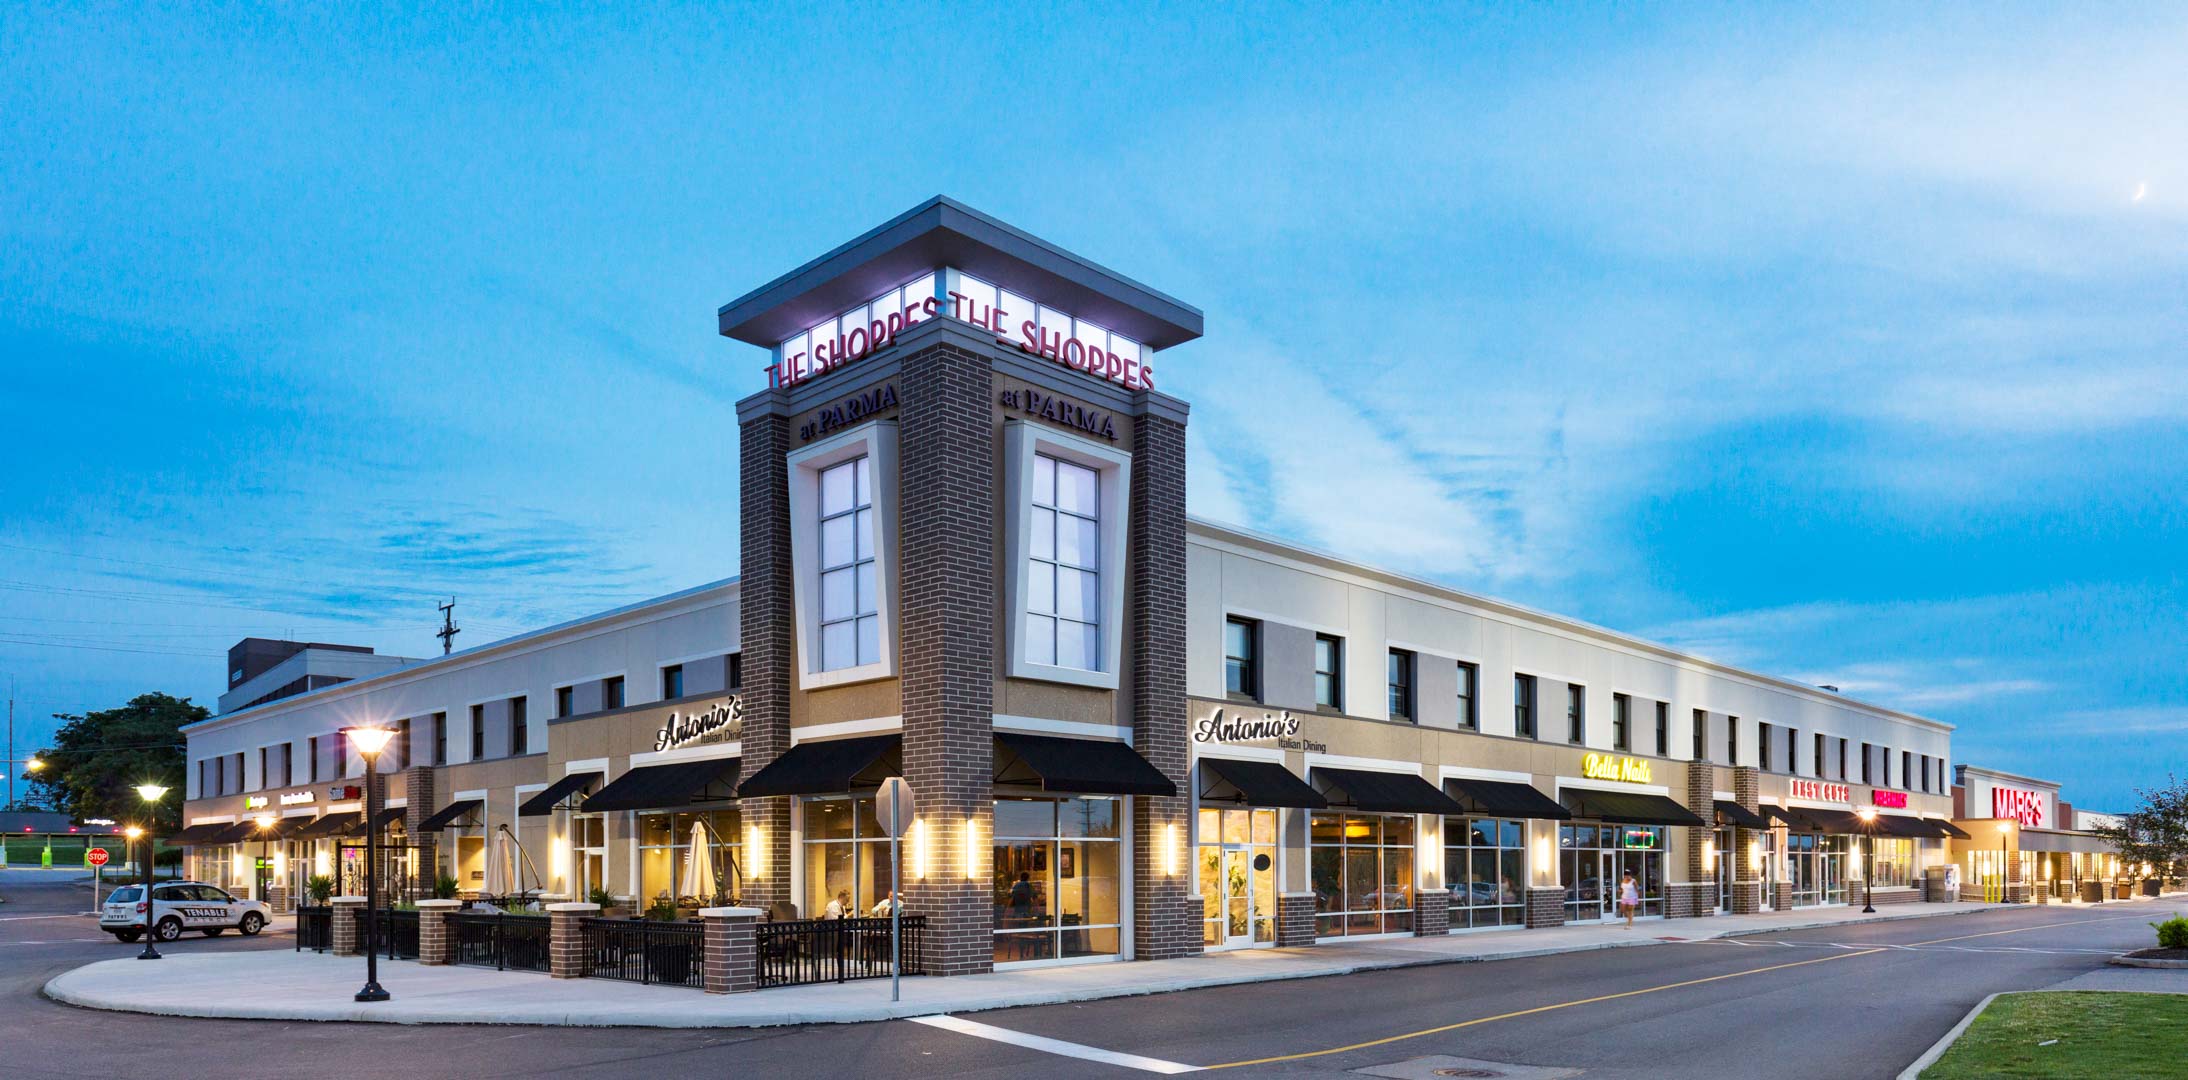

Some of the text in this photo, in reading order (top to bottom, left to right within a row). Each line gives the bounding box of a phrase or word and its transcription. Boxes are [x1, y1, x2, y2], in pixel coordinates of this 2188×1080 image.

[764, 296, 943, 388] THE SHOPPES
[948, 290, 1154, 391] THE SHOPPES
[800, 383, 898, 440] at PARMA
[1002, 388, 1118, 441] at PARMA
[654, 695, 742, 752] Antonio's
[700, 728, 741, 745] Italian Dini
[1194, 708, 1300, 743] Antonio's
[1278, 737, 1327, 754] Italian Dining
[1583, 752, 1651, 783] Bella Nails
[1790, 778, 1849, 803] BEST CUTS
[1992, 786, 2043, 827] MARC'S
[89, 853, 107, 861] STOP
[185, 908, 226, 918] TENABLE
